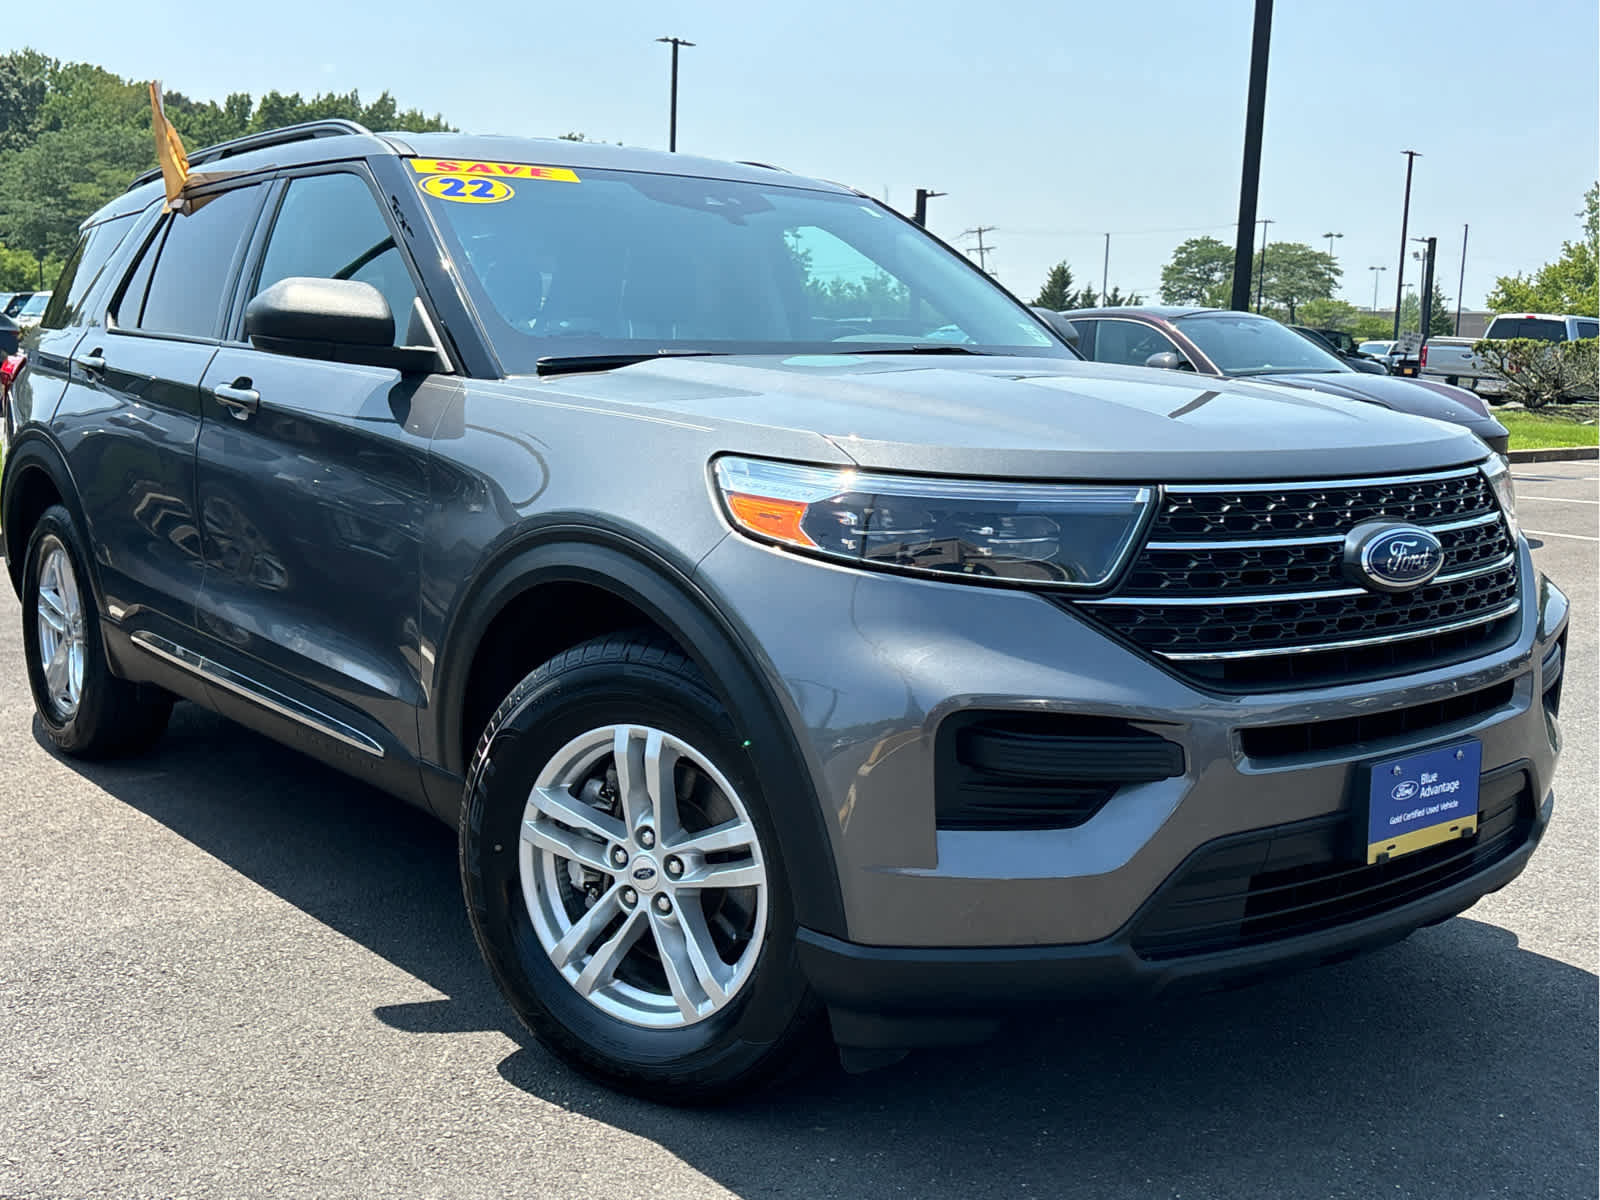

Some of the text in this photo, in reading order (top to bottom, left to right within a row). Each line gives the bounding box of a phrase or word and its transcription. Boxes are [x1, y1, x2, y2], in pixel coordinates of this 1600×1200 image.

[435, 161, 552, 178] SAVE
[438, 177, 495, 199] 22
[1386, 540, 1434, 574] Ford
[1421, 773, 1438, 785] Blue
[1419, 780, 1460, 799] Advantage
[1390, 800, 1458, 824] Gold Certified Used Vehicle
